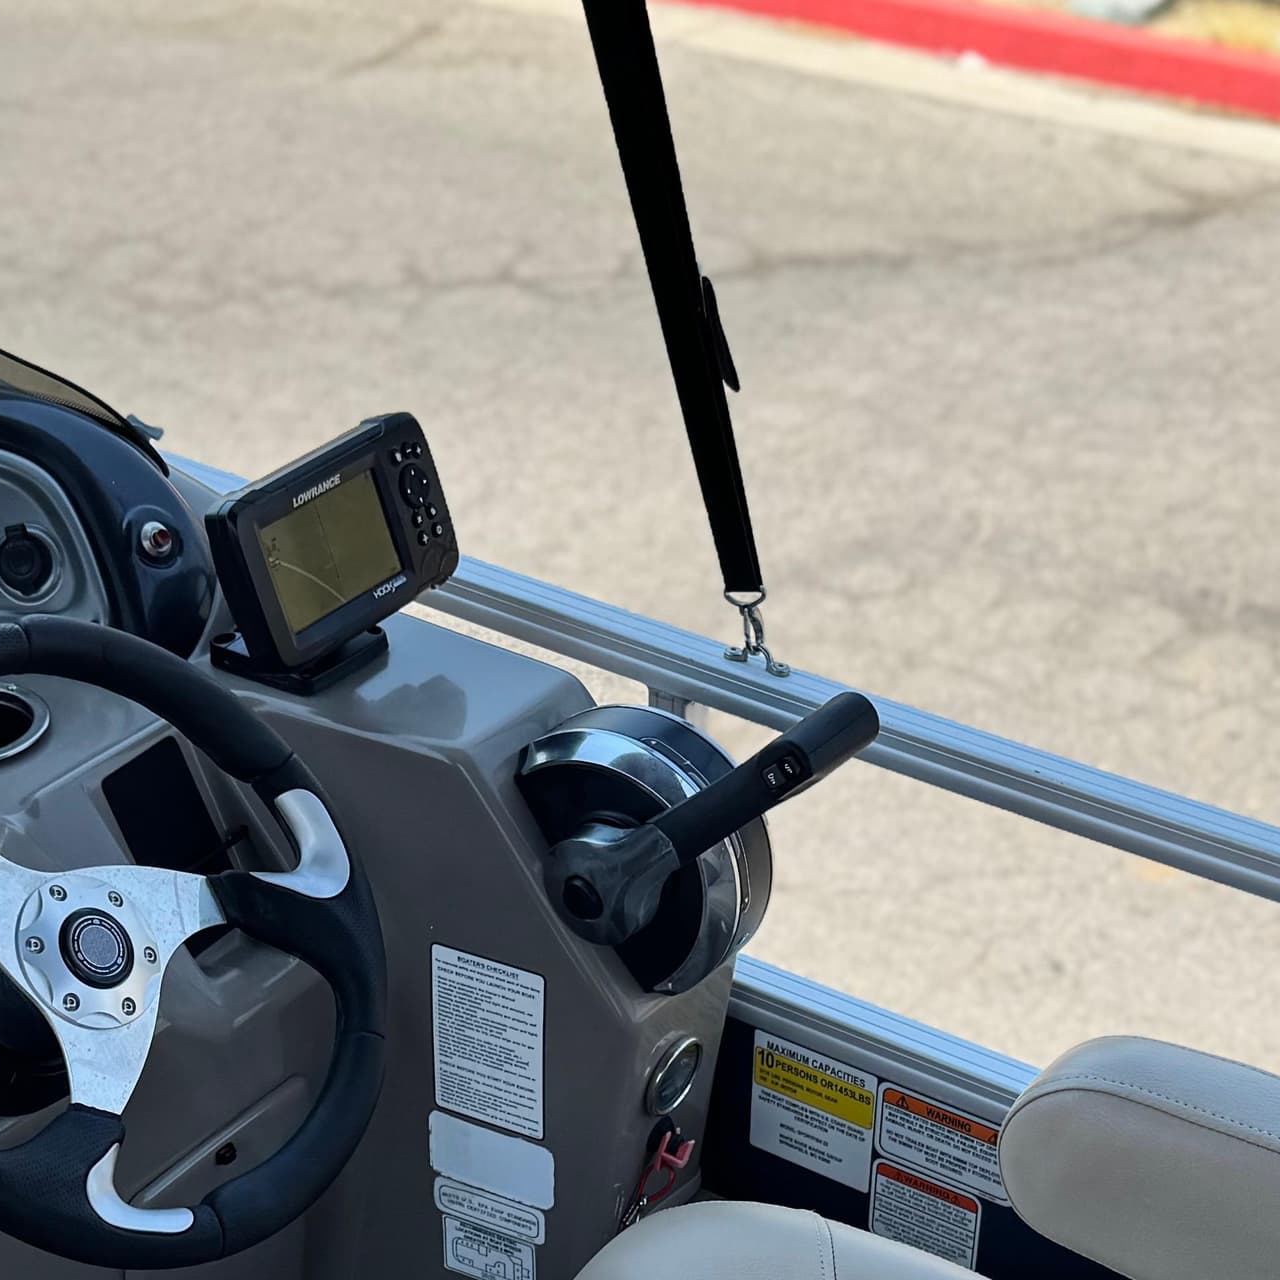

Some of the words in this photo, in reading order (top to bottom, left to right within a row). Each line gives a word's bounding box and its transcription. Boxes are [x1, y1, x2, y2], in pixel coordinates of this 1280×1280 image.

[292, 473, 341, 509] LOWRANCE
[757, 1047, 774, 1070] 10
[775, 1059, 818, 1084] PERSONS
[766, 1040, 809, 1065] MAXIMUM
[811, 1058, 866, 1088] CAPACITIES
[926, 1106, 971, 1133] WARNING
[903, 1175, 949, 1200] WARNING
